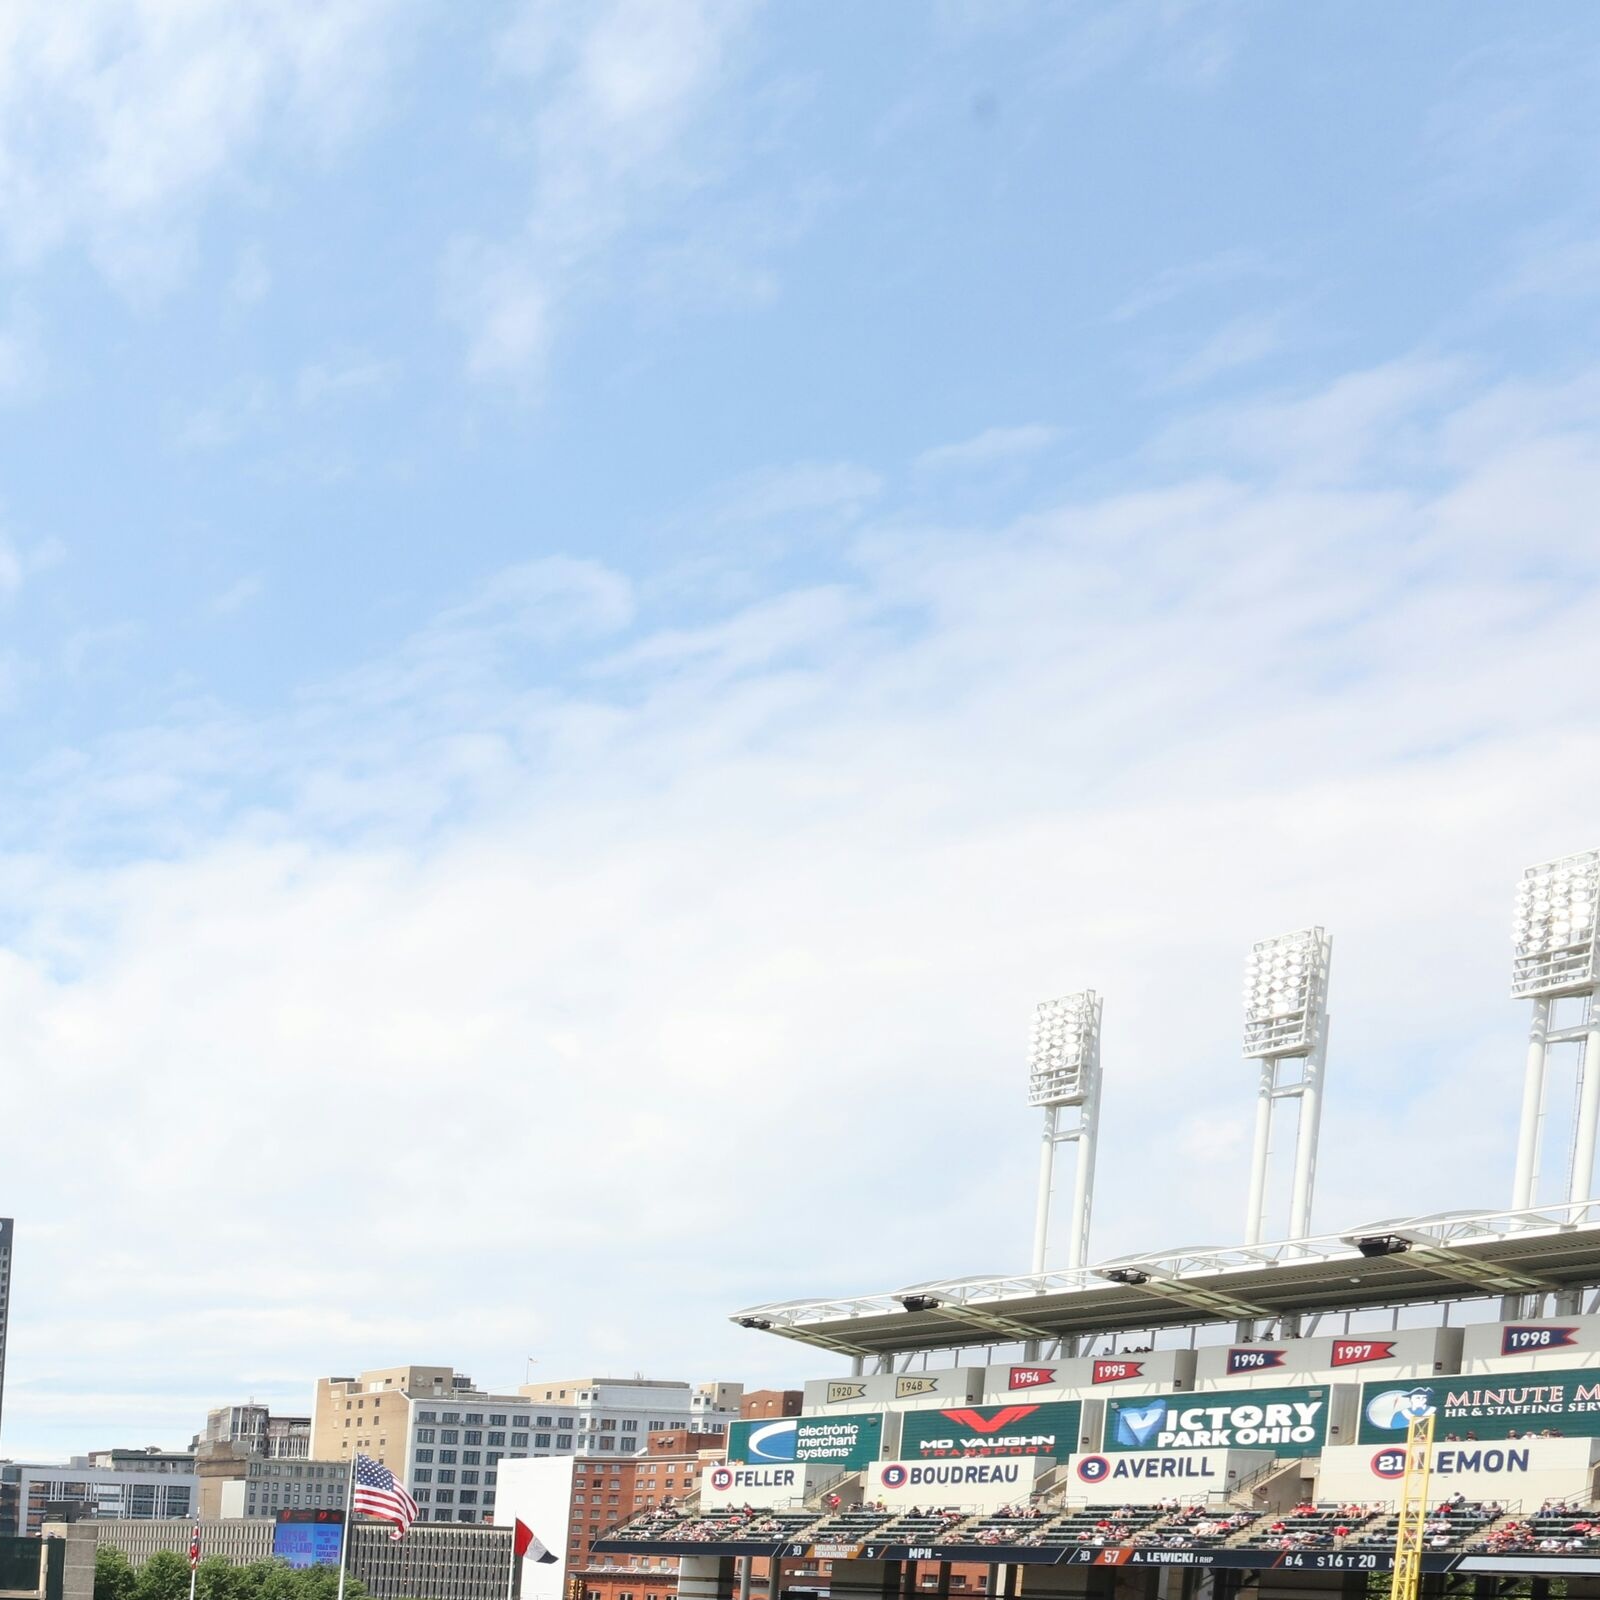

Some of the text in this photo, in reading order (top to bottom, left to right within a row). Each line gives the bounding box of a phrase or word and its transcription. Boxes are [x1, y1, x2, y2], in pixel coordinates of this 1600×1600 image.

[1511, 1331, 1551, 1347] 1998
[1337, 1345, 1372, 1360] 1997
[1234, 1353, 1265, 1368] 1996
[1014, 1372, 1040, 1384] 1954
[1098, 1364, 1126, 1378] 1995
[831, 1386, 853, 1398] 1920
[901, 1380, 923, 1392] 1948
[1444, 1385, 1564, 1408] MINUTE
[1445, 1408, 1468, 1418] HR
[1471, 1407, 1483, 1416] &
[1486, 1404, 1563, 1416] STAFFING
[798, 1423, 859, 1437] electronic
[1123, 1401, 1323, 1444] VICTORY
[798, 1434, 857, 1447] merchant
[920, 1435, 1056, 1450] MO VAUGHN
[1157, 1426, 1316, 1448] PARK OHIO
[920, 1445, 1052, 1457] TRANSPORT
[1087, 1456, 1215, 1479] 3 AVERILL
[1378, 1456, 1404, 1471] 21
[715, 1469, 795, 1487] 19 FELLER
[889, 1464, 1019, 1485] 5 BOUDREAU
[814, 1544, 835, 1552] MOUND
[908, 1548, 932, 1559] MPH
